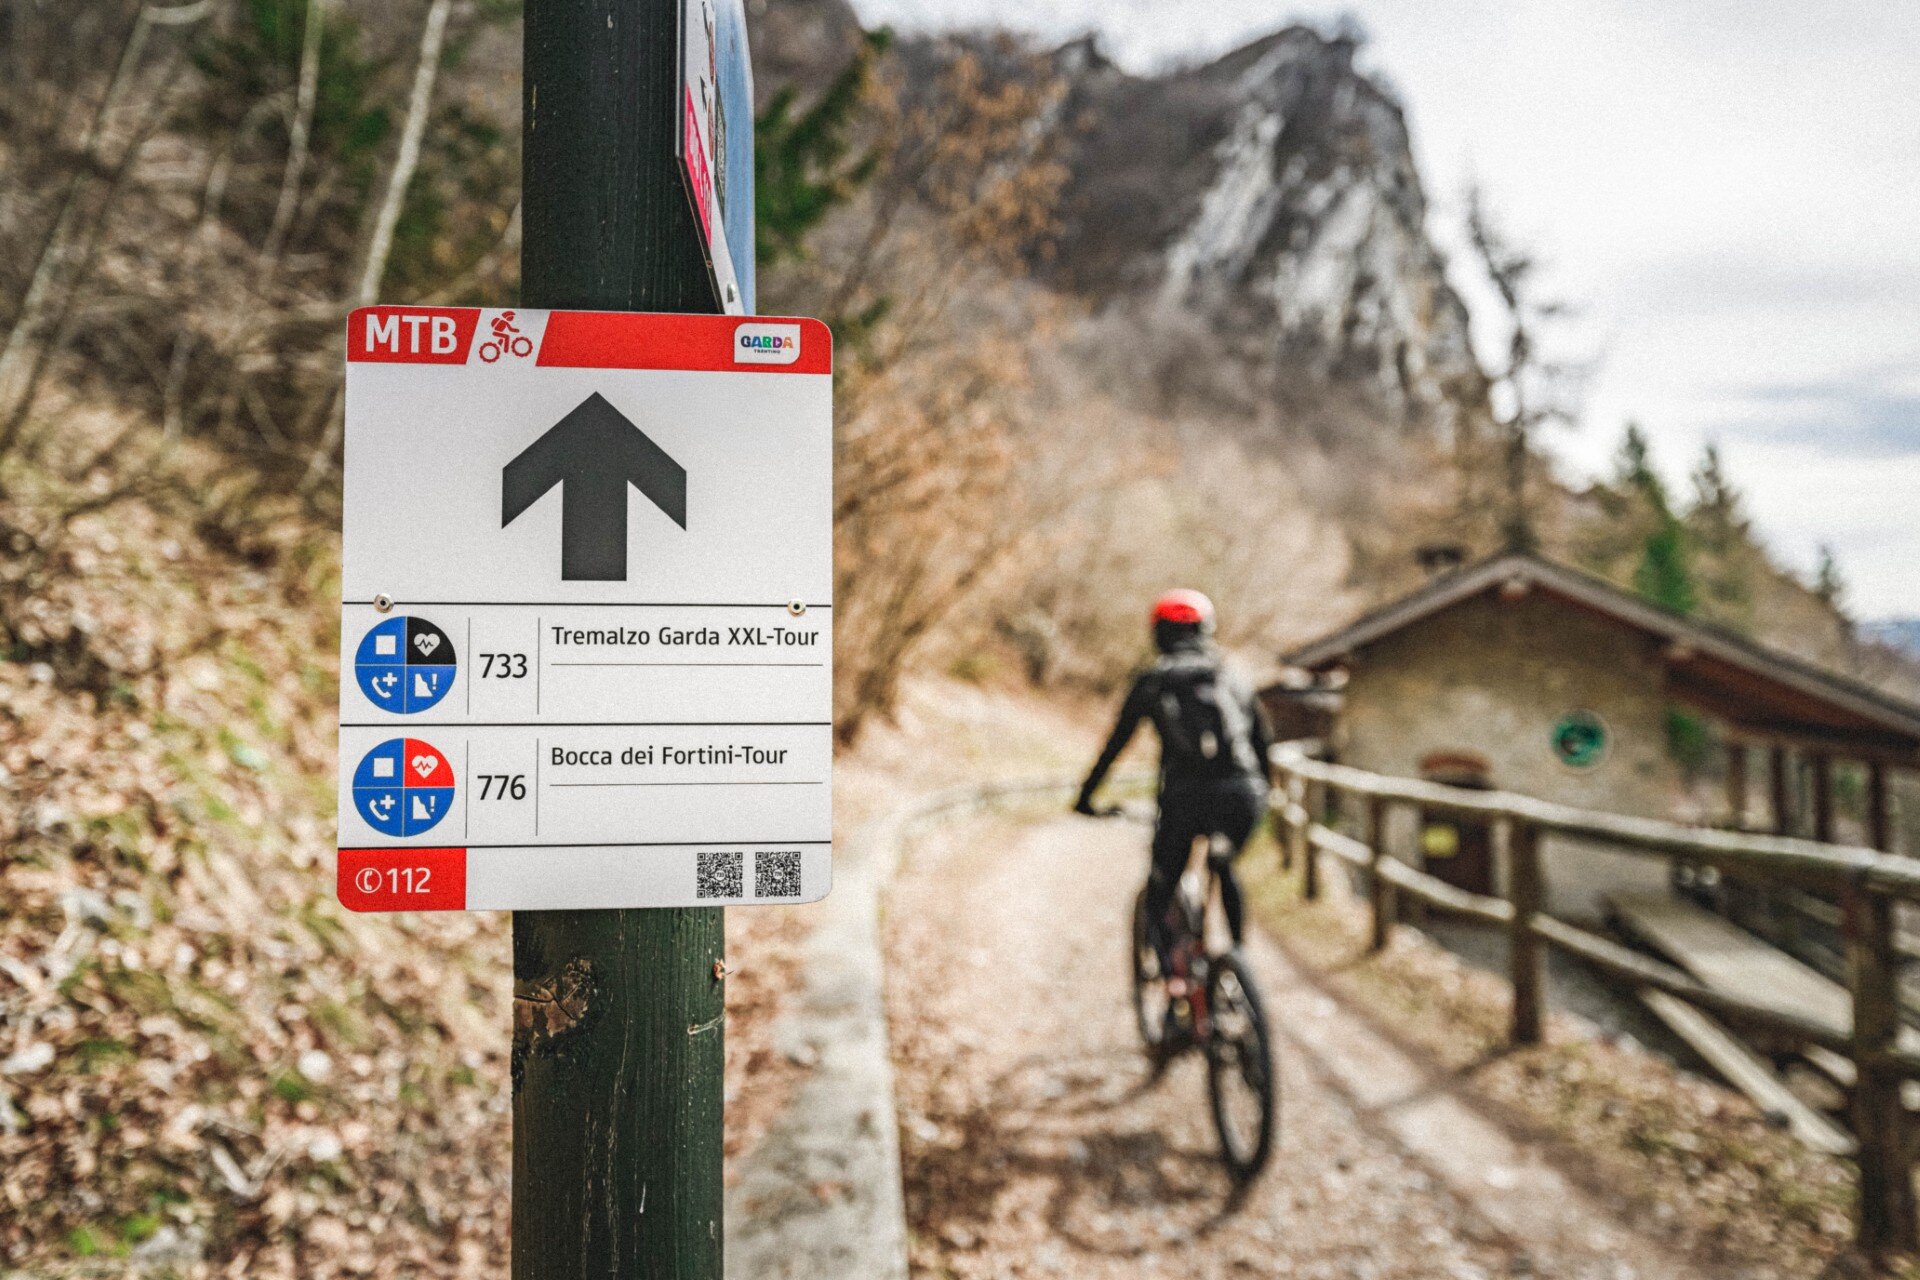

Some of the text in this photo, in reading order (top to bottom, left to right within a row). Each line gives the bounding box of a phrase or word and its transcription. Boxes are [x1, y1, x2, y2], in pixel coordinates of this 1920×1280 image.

[366, 314, 458, 354] MTB
[740, 335, 794, 349] GARDA
[551, 626, 819, 646] Tremalzo Garda XXL-Tour
[479, 653, 528, 679] 733
[551, 744, 788, 766] Bocca dei Fortini-Tour
[477, 774, 526, 801] 776
[386, 867, 431, 894] 112
